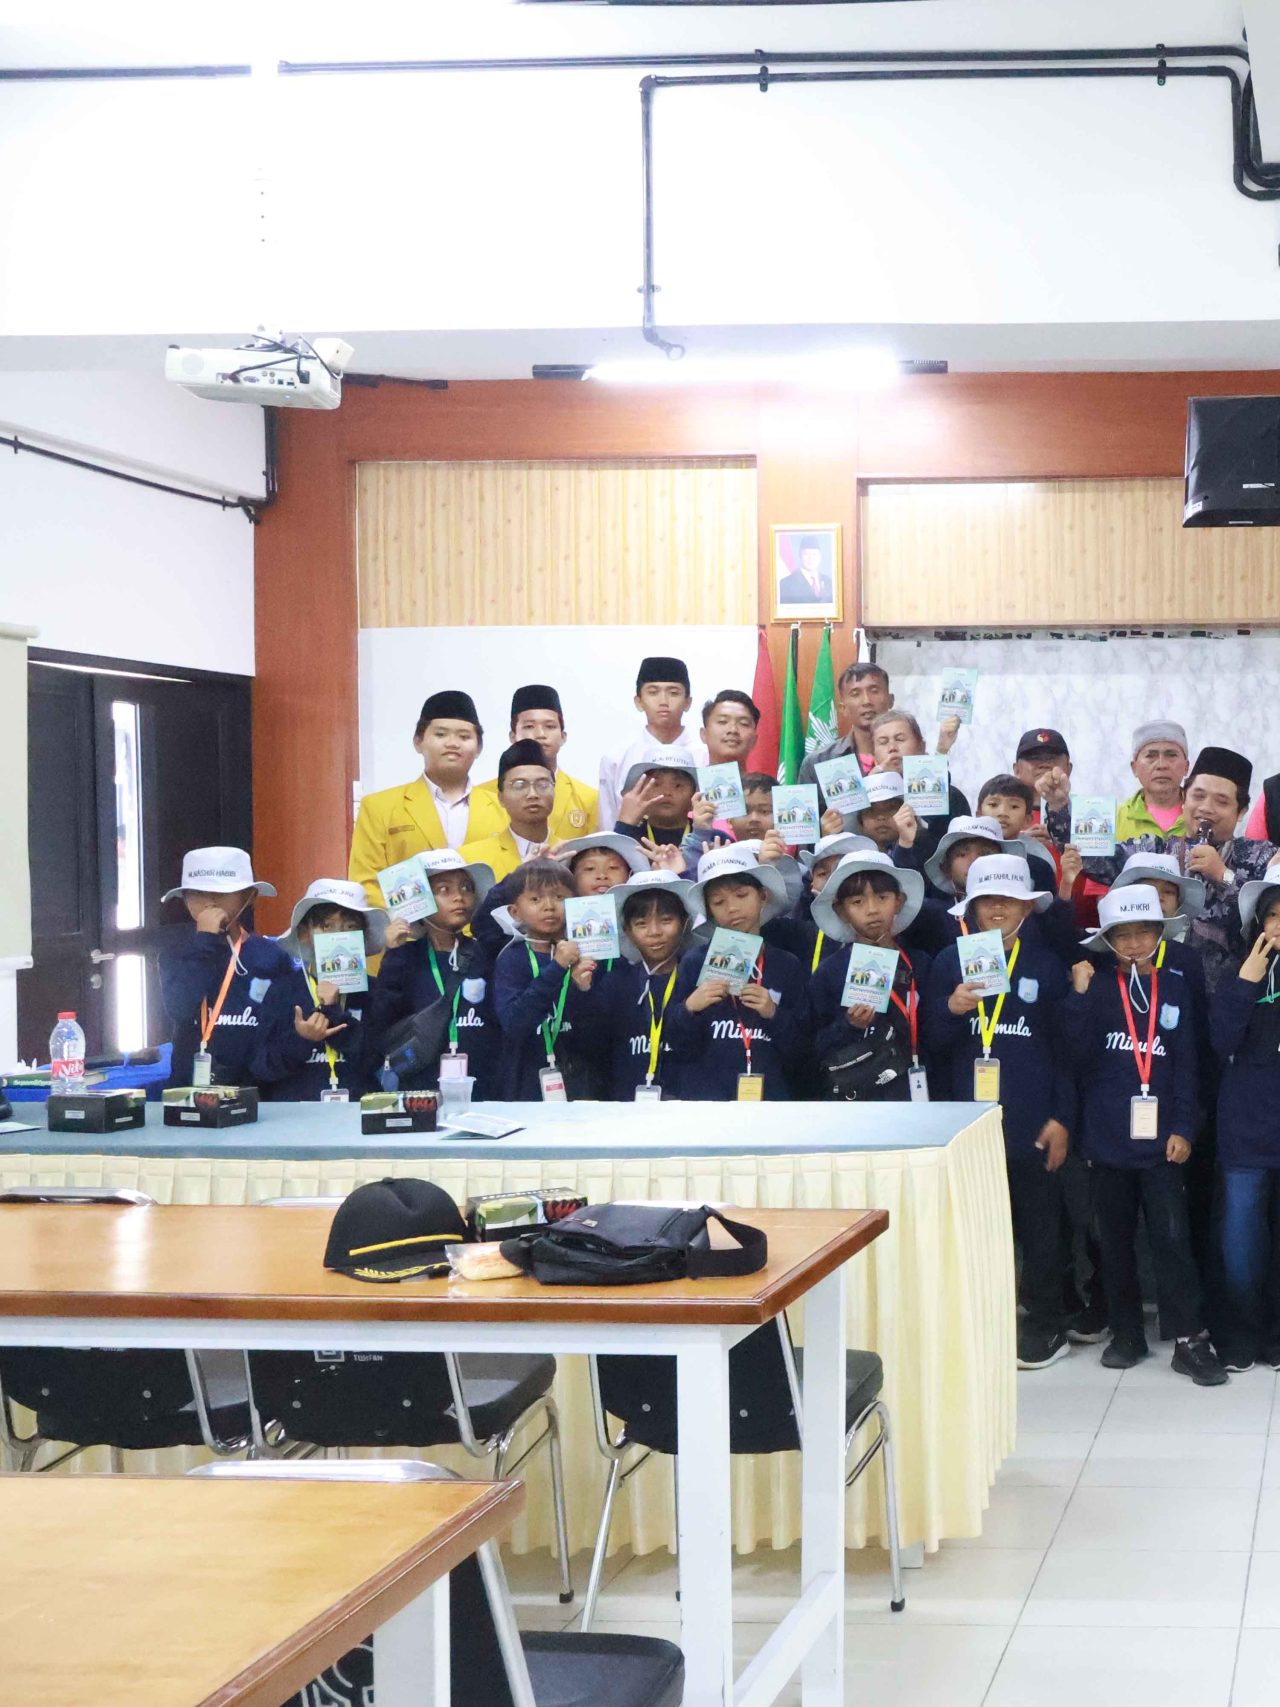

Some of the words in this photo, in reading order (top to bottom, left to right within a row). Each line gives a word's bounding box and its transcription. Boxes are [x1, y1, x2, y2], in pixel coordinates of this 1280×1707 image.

[1119, 903, 1150, 913] M.FIKRI
[969, 1015, 1032, 1037] Mmula
[1105, 1031, 1167, 1057] Miula
